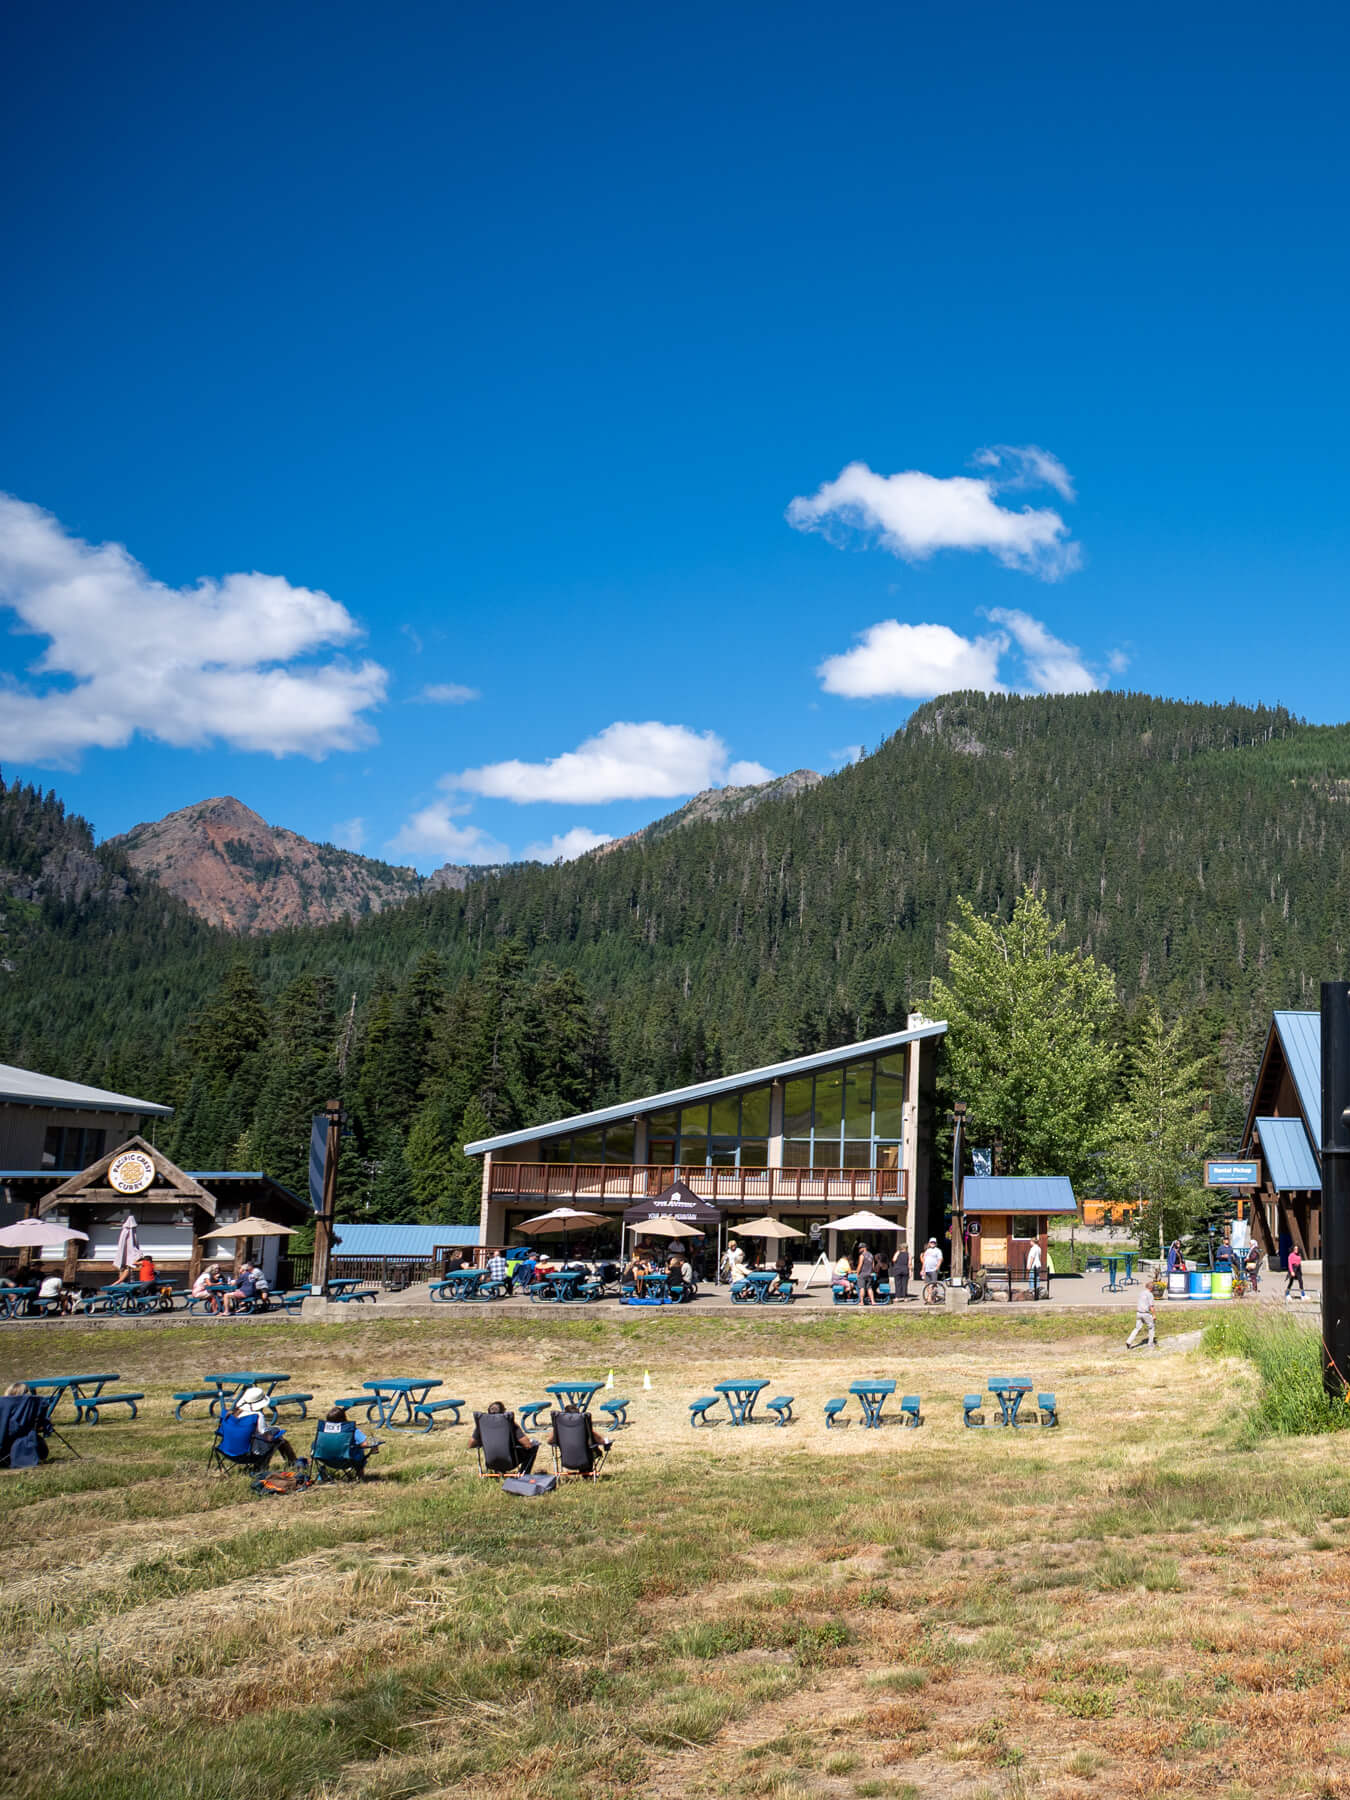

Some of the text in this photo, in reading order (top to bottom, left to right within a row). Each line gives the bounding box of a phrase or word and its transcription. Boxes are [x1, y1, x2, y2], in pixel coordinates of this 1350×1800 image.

[112, 1154, 151, 1173] PACIFIC CREST
[118, 1181, 143, 1190] CURRY
